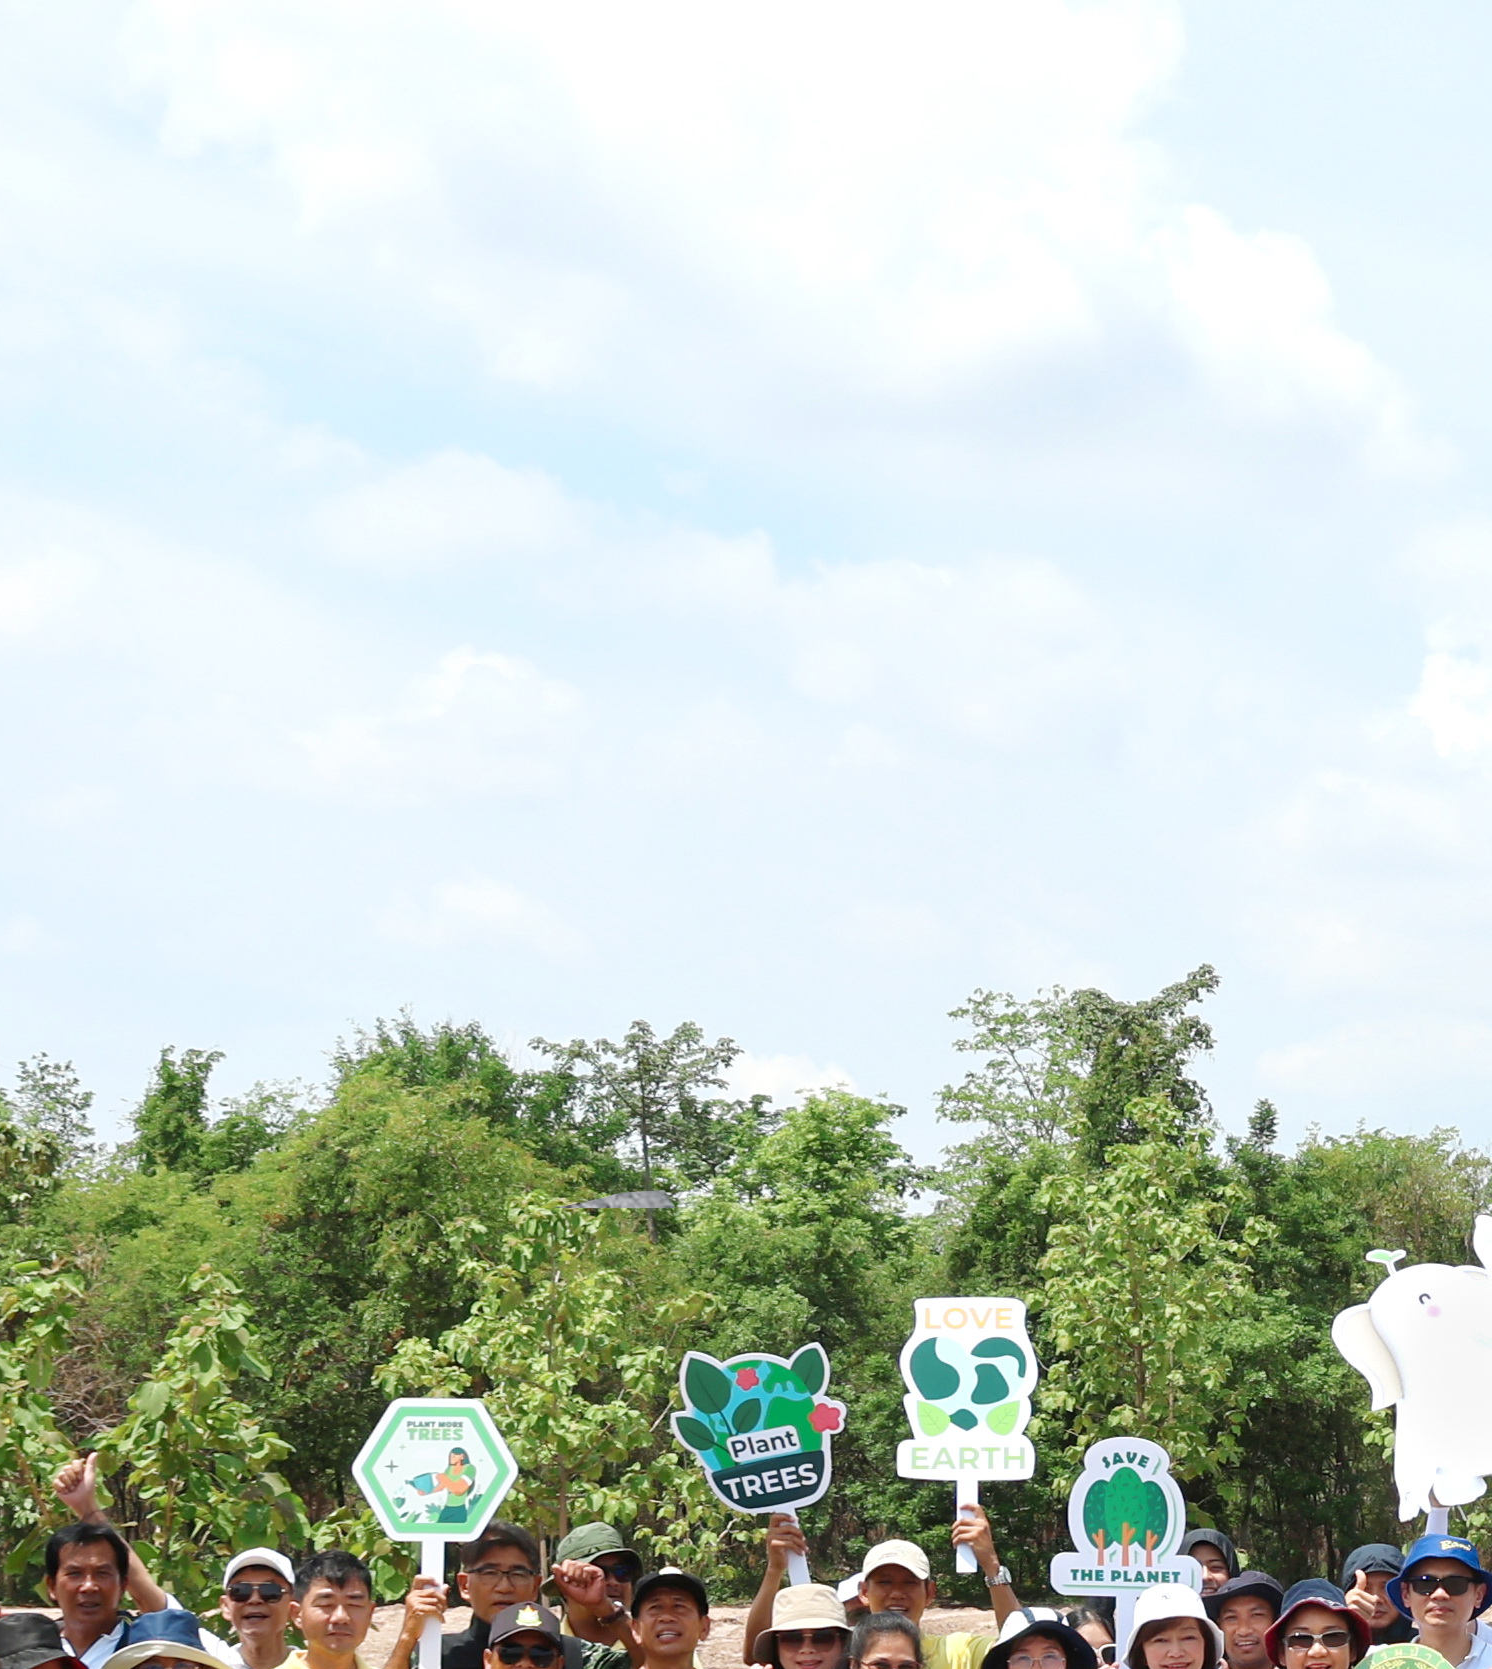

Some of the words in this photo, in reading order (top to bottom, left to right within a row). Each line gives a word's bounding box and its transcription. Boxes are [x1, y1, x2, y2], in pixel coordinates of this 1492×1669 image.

[924, 1306, 1013, 1331] LOVE
[406, 1428, 464, 1441] TREES
[729, 1426, 798, 1460] Plant
[910, 1445, 1026, 1471] EARTH
[1102, 1451, 1151, 1470] SAVE
[722, 1463, 820, 1500] TREES
[1070, 1568, 1104, 1583] THE
[1110, 1568, 1182, 1584] PLANET
